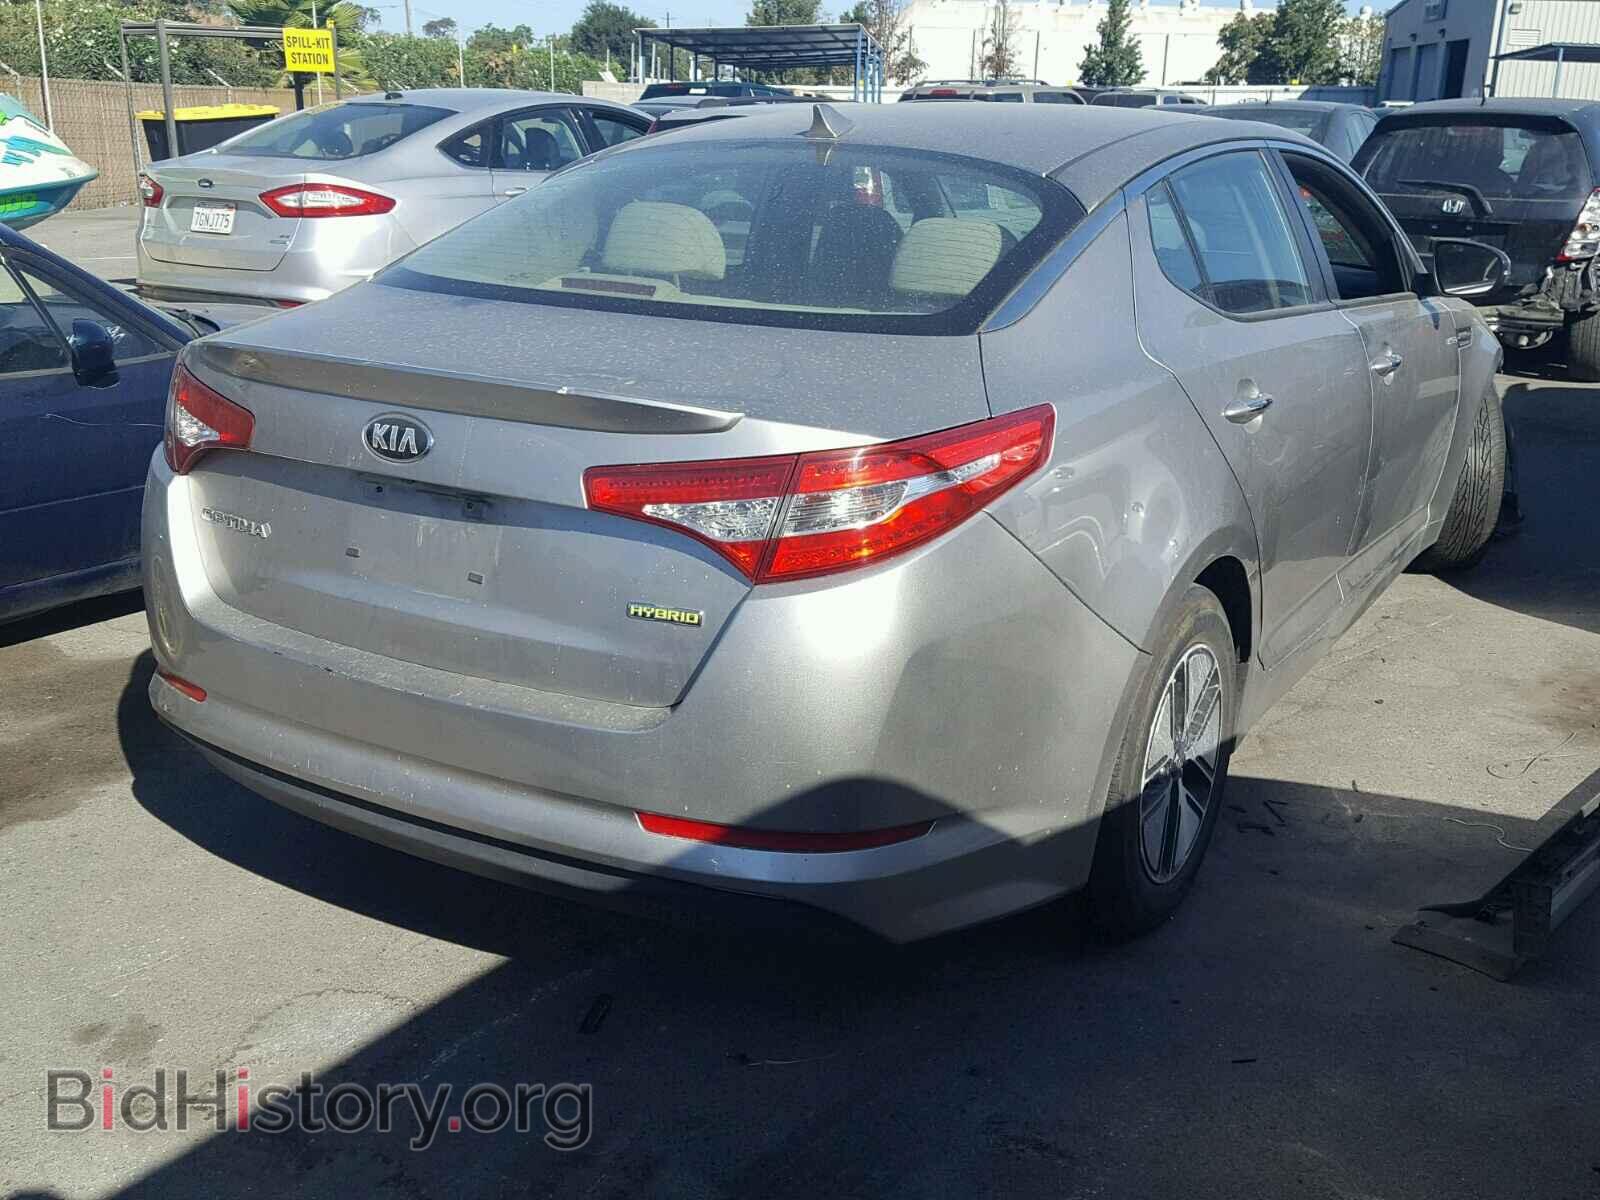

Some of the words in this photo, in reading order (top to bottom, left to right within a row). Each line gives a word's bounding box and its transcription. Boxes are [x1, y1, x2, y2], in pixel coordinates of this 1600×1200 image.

[286, 35, 330, 49] SPILL-KIT
[291, 51, 329, 65] STATION
[194, 211, 231, 229] 7GNJ775
[372, 422, 418, 455] KIA
[630, 604, 699, 624] HYBRID
